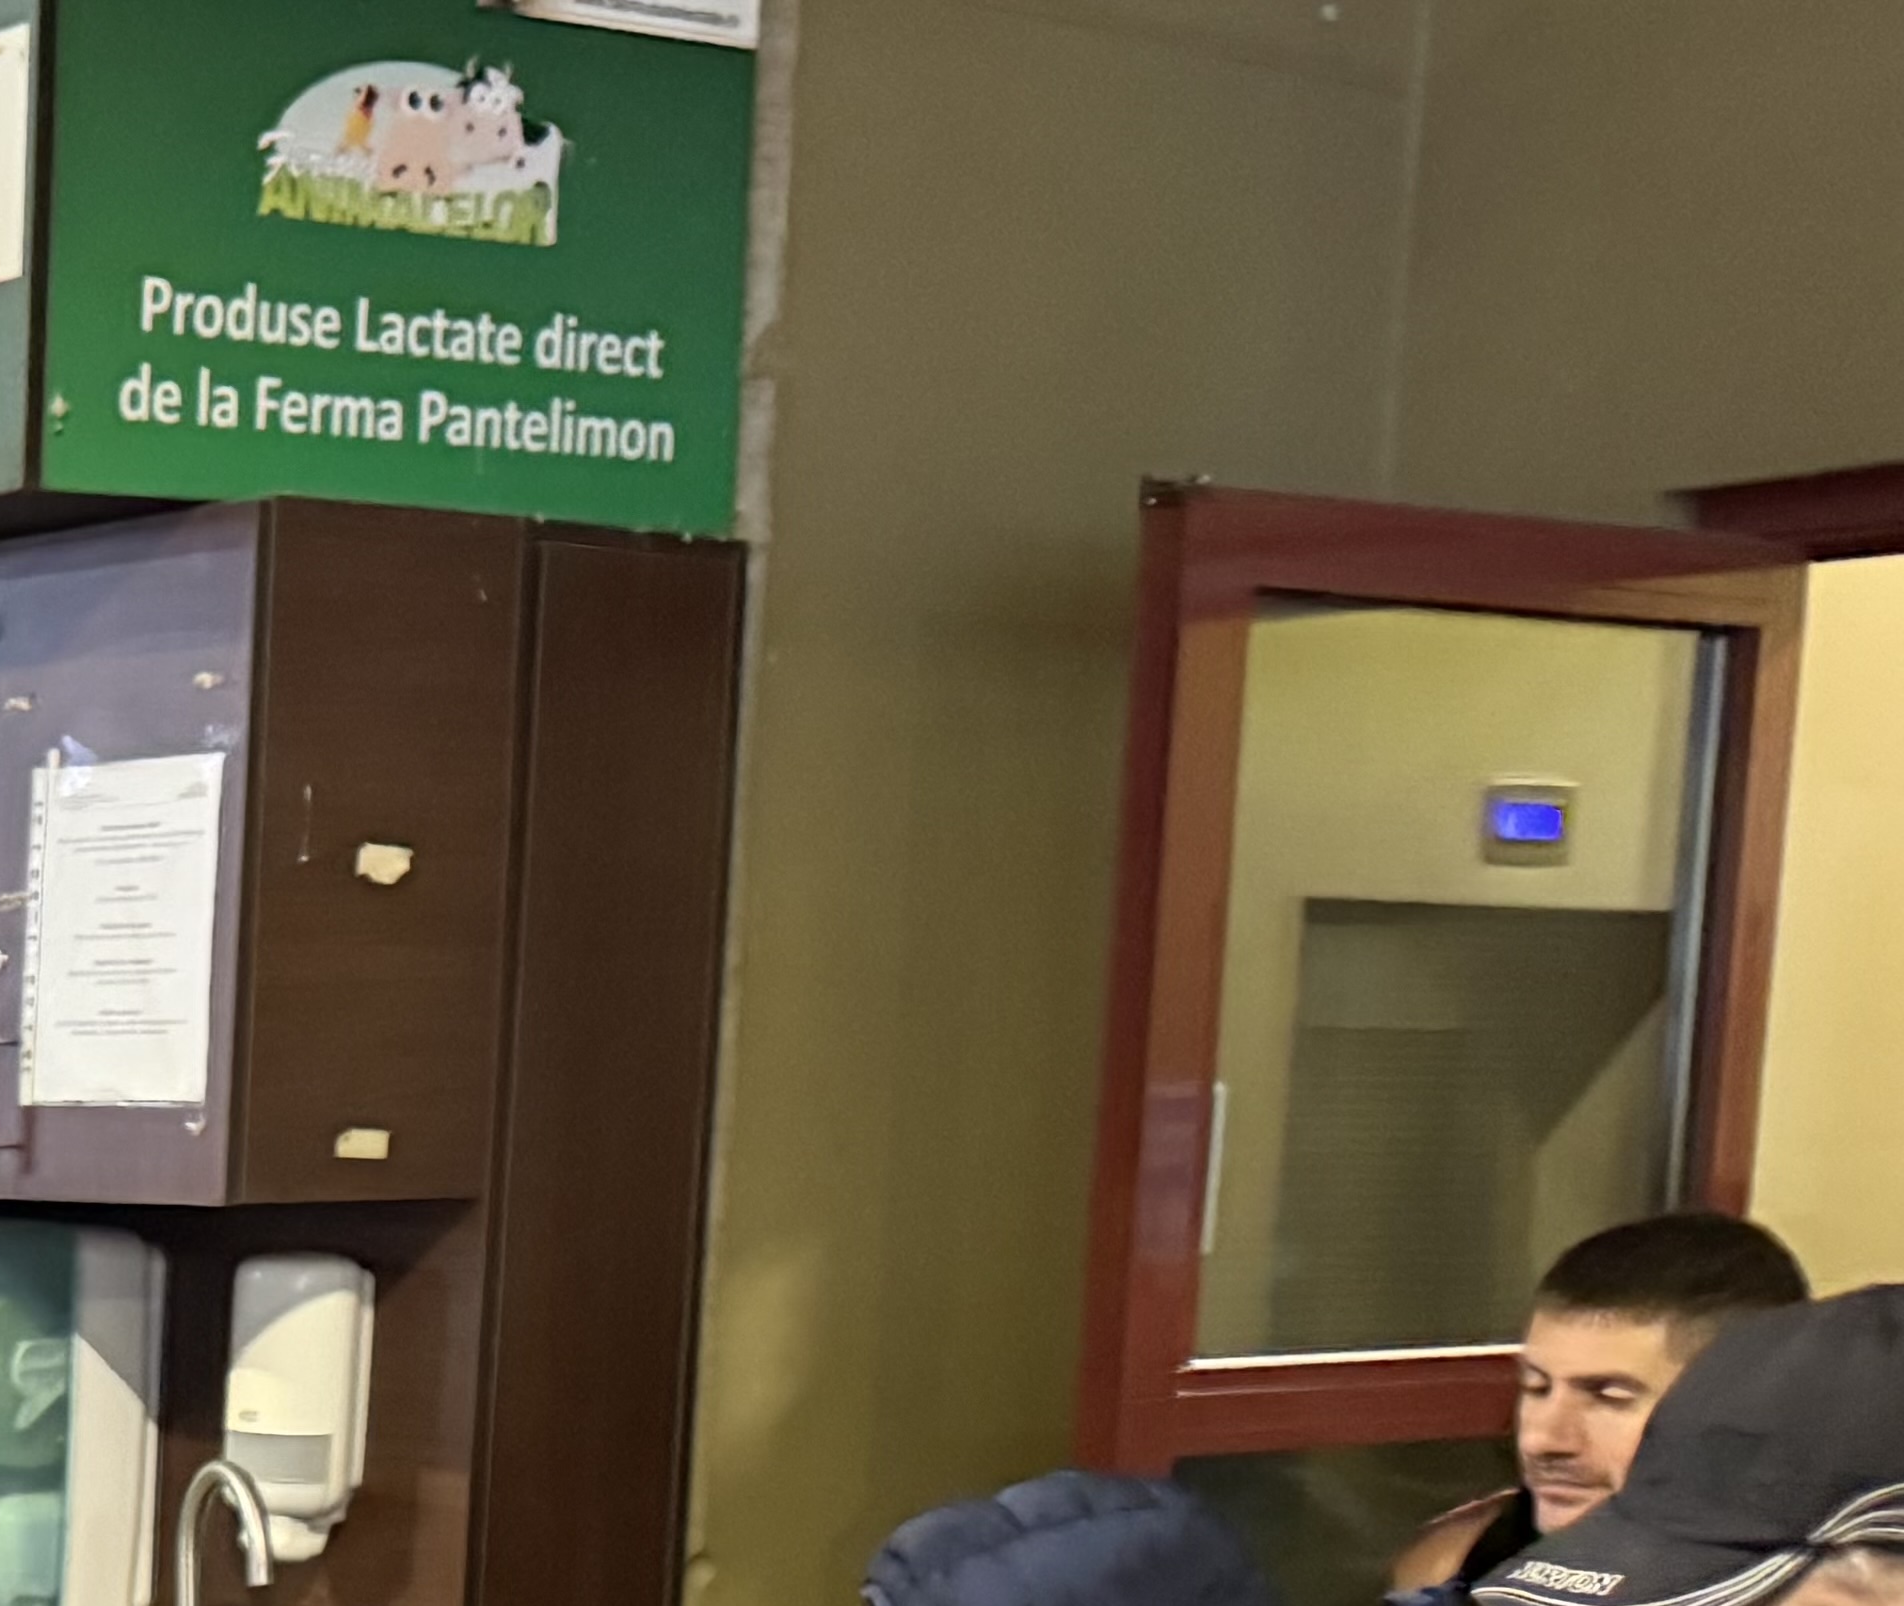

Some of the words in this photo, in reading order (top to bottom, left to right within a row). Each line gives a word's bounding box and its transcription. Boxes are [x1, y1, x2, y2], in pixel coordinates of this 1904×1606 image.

[140, 275, 341, 350] Produse
[354, 297, 522, 366] Lactate
[534, 312, 665, 379] direct
[118, 362, 183, 425] de
[197, 367, 238, 429] la
[254, 377, 403, 442] Ferma
[418, 390, 676, 463] Pantelimon
